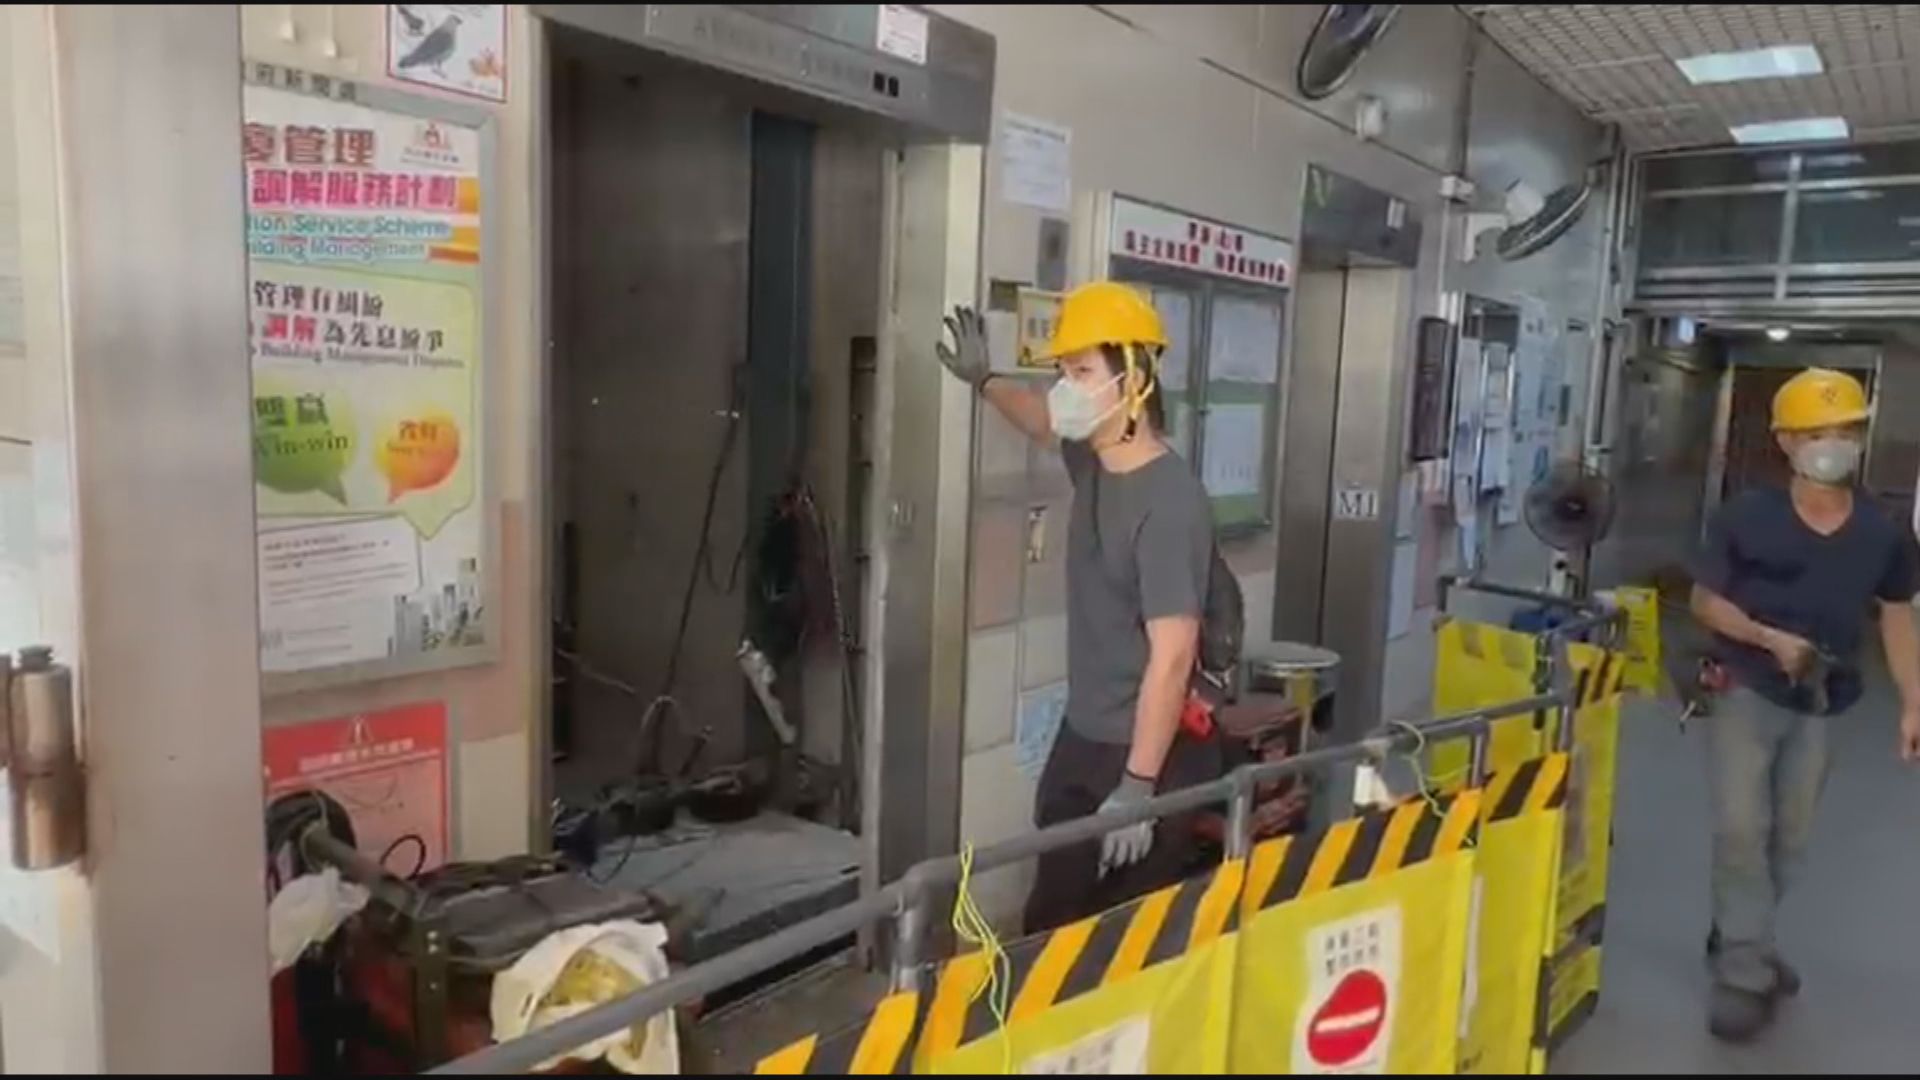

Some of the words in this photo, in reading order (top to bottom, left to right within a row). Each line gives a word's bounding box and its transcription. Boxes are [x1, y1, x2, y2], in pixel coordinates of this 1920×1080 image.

[252, 169, 456, 208] 調解服務計劃
[292, 214, 370, 235] Service
[373, 217, 450, 236] Scheme
[246, 313, 444, 352] 調解為先息紛爭
[1339, 491, 1376, 518] M1
